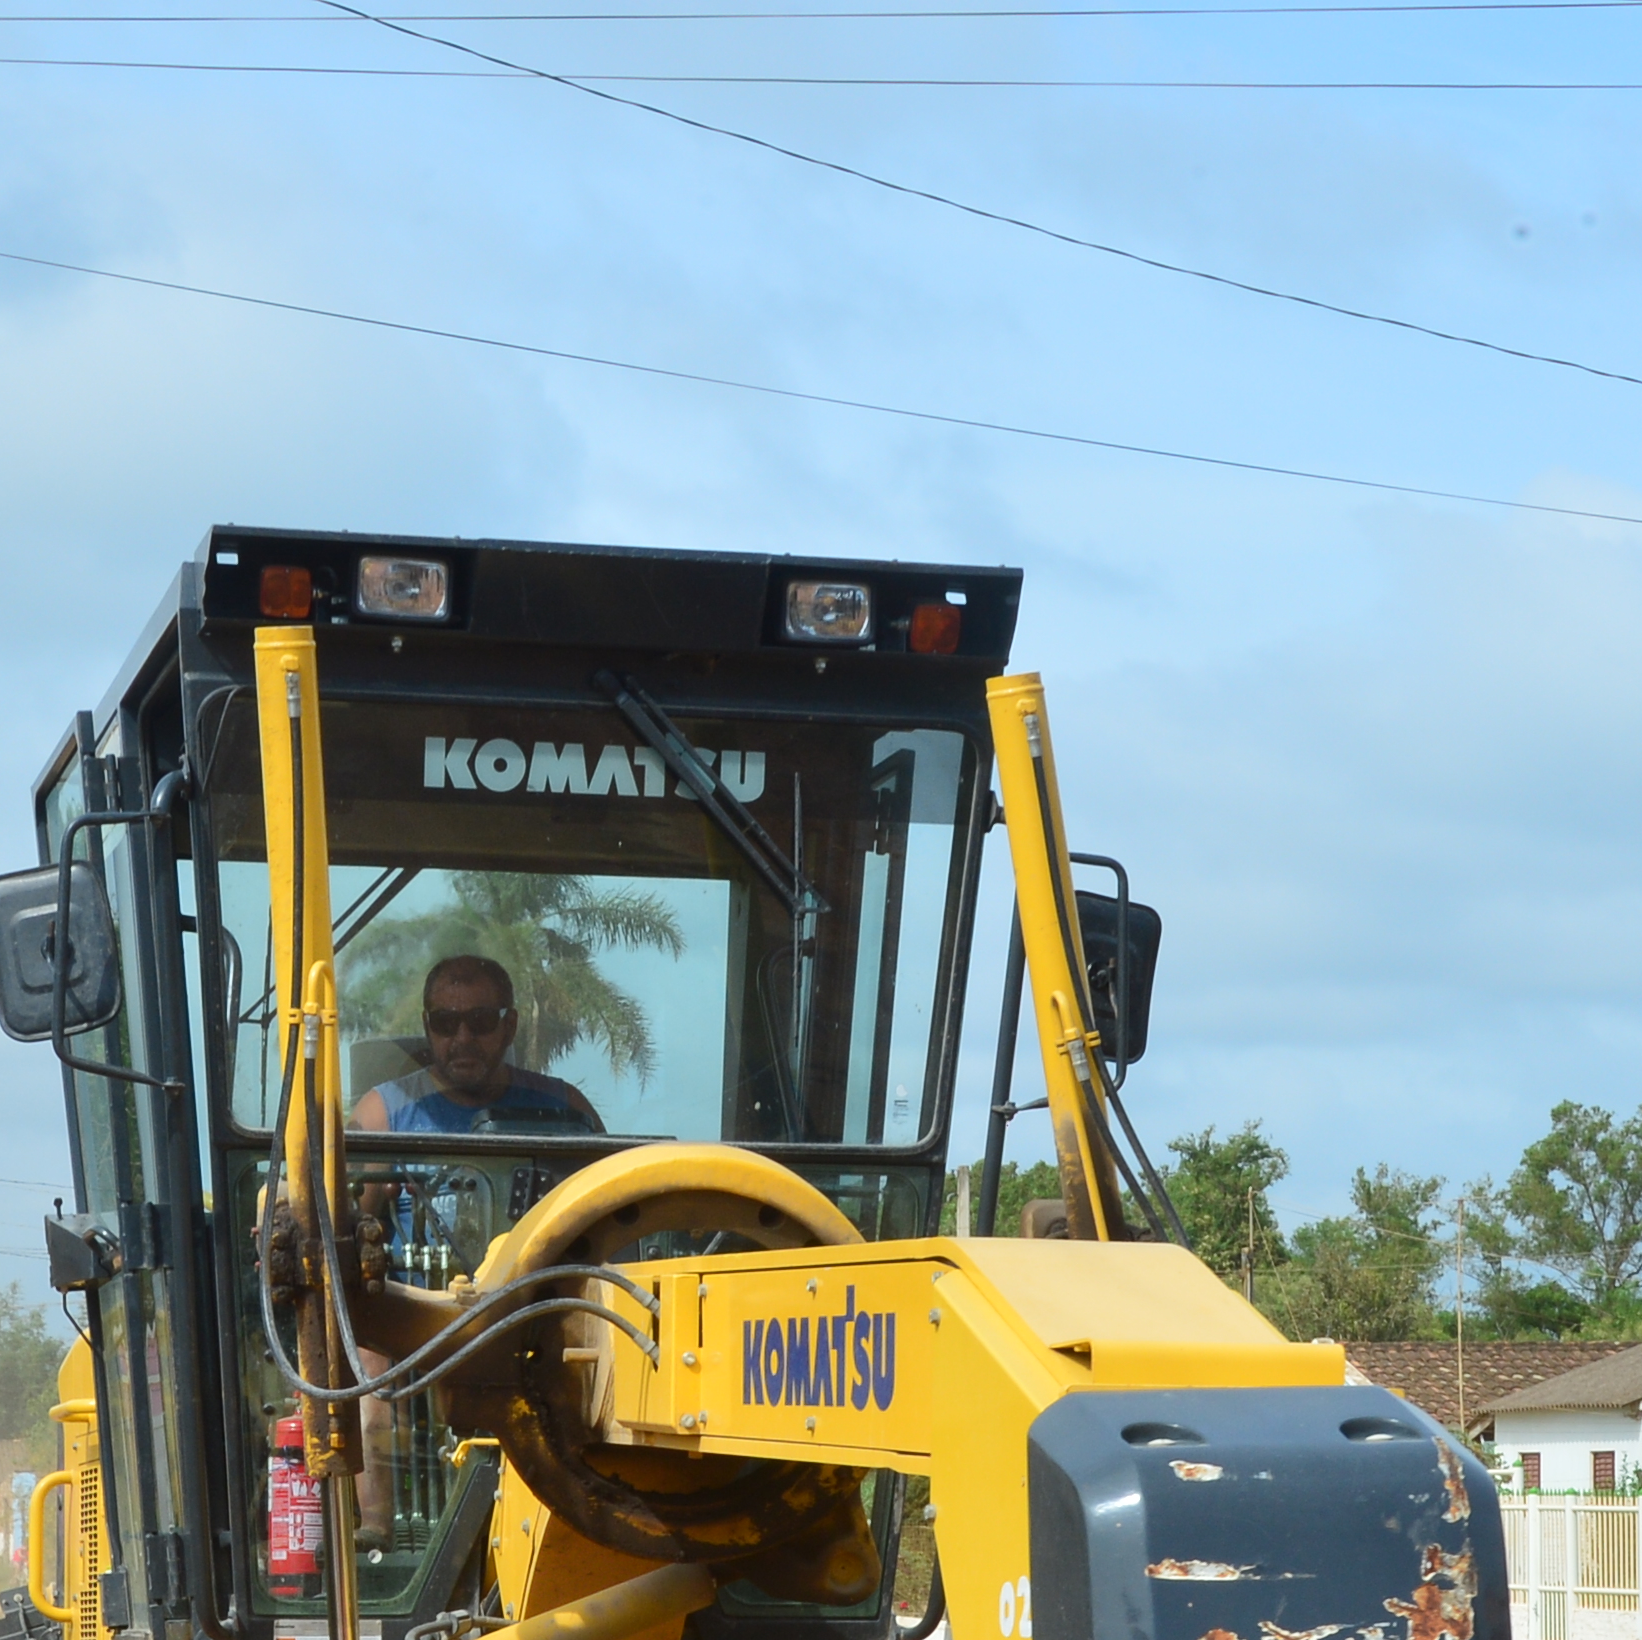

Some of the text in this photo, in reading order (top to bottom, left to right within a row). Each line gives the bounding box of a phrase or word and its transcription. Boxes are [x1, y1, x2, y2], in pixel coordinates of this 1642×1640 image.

[423, 733, 766, 803] KOMATSU
[743, 1284, 896, 1412] KOMATSU
[998, 1575, 1033, 1638] 02
